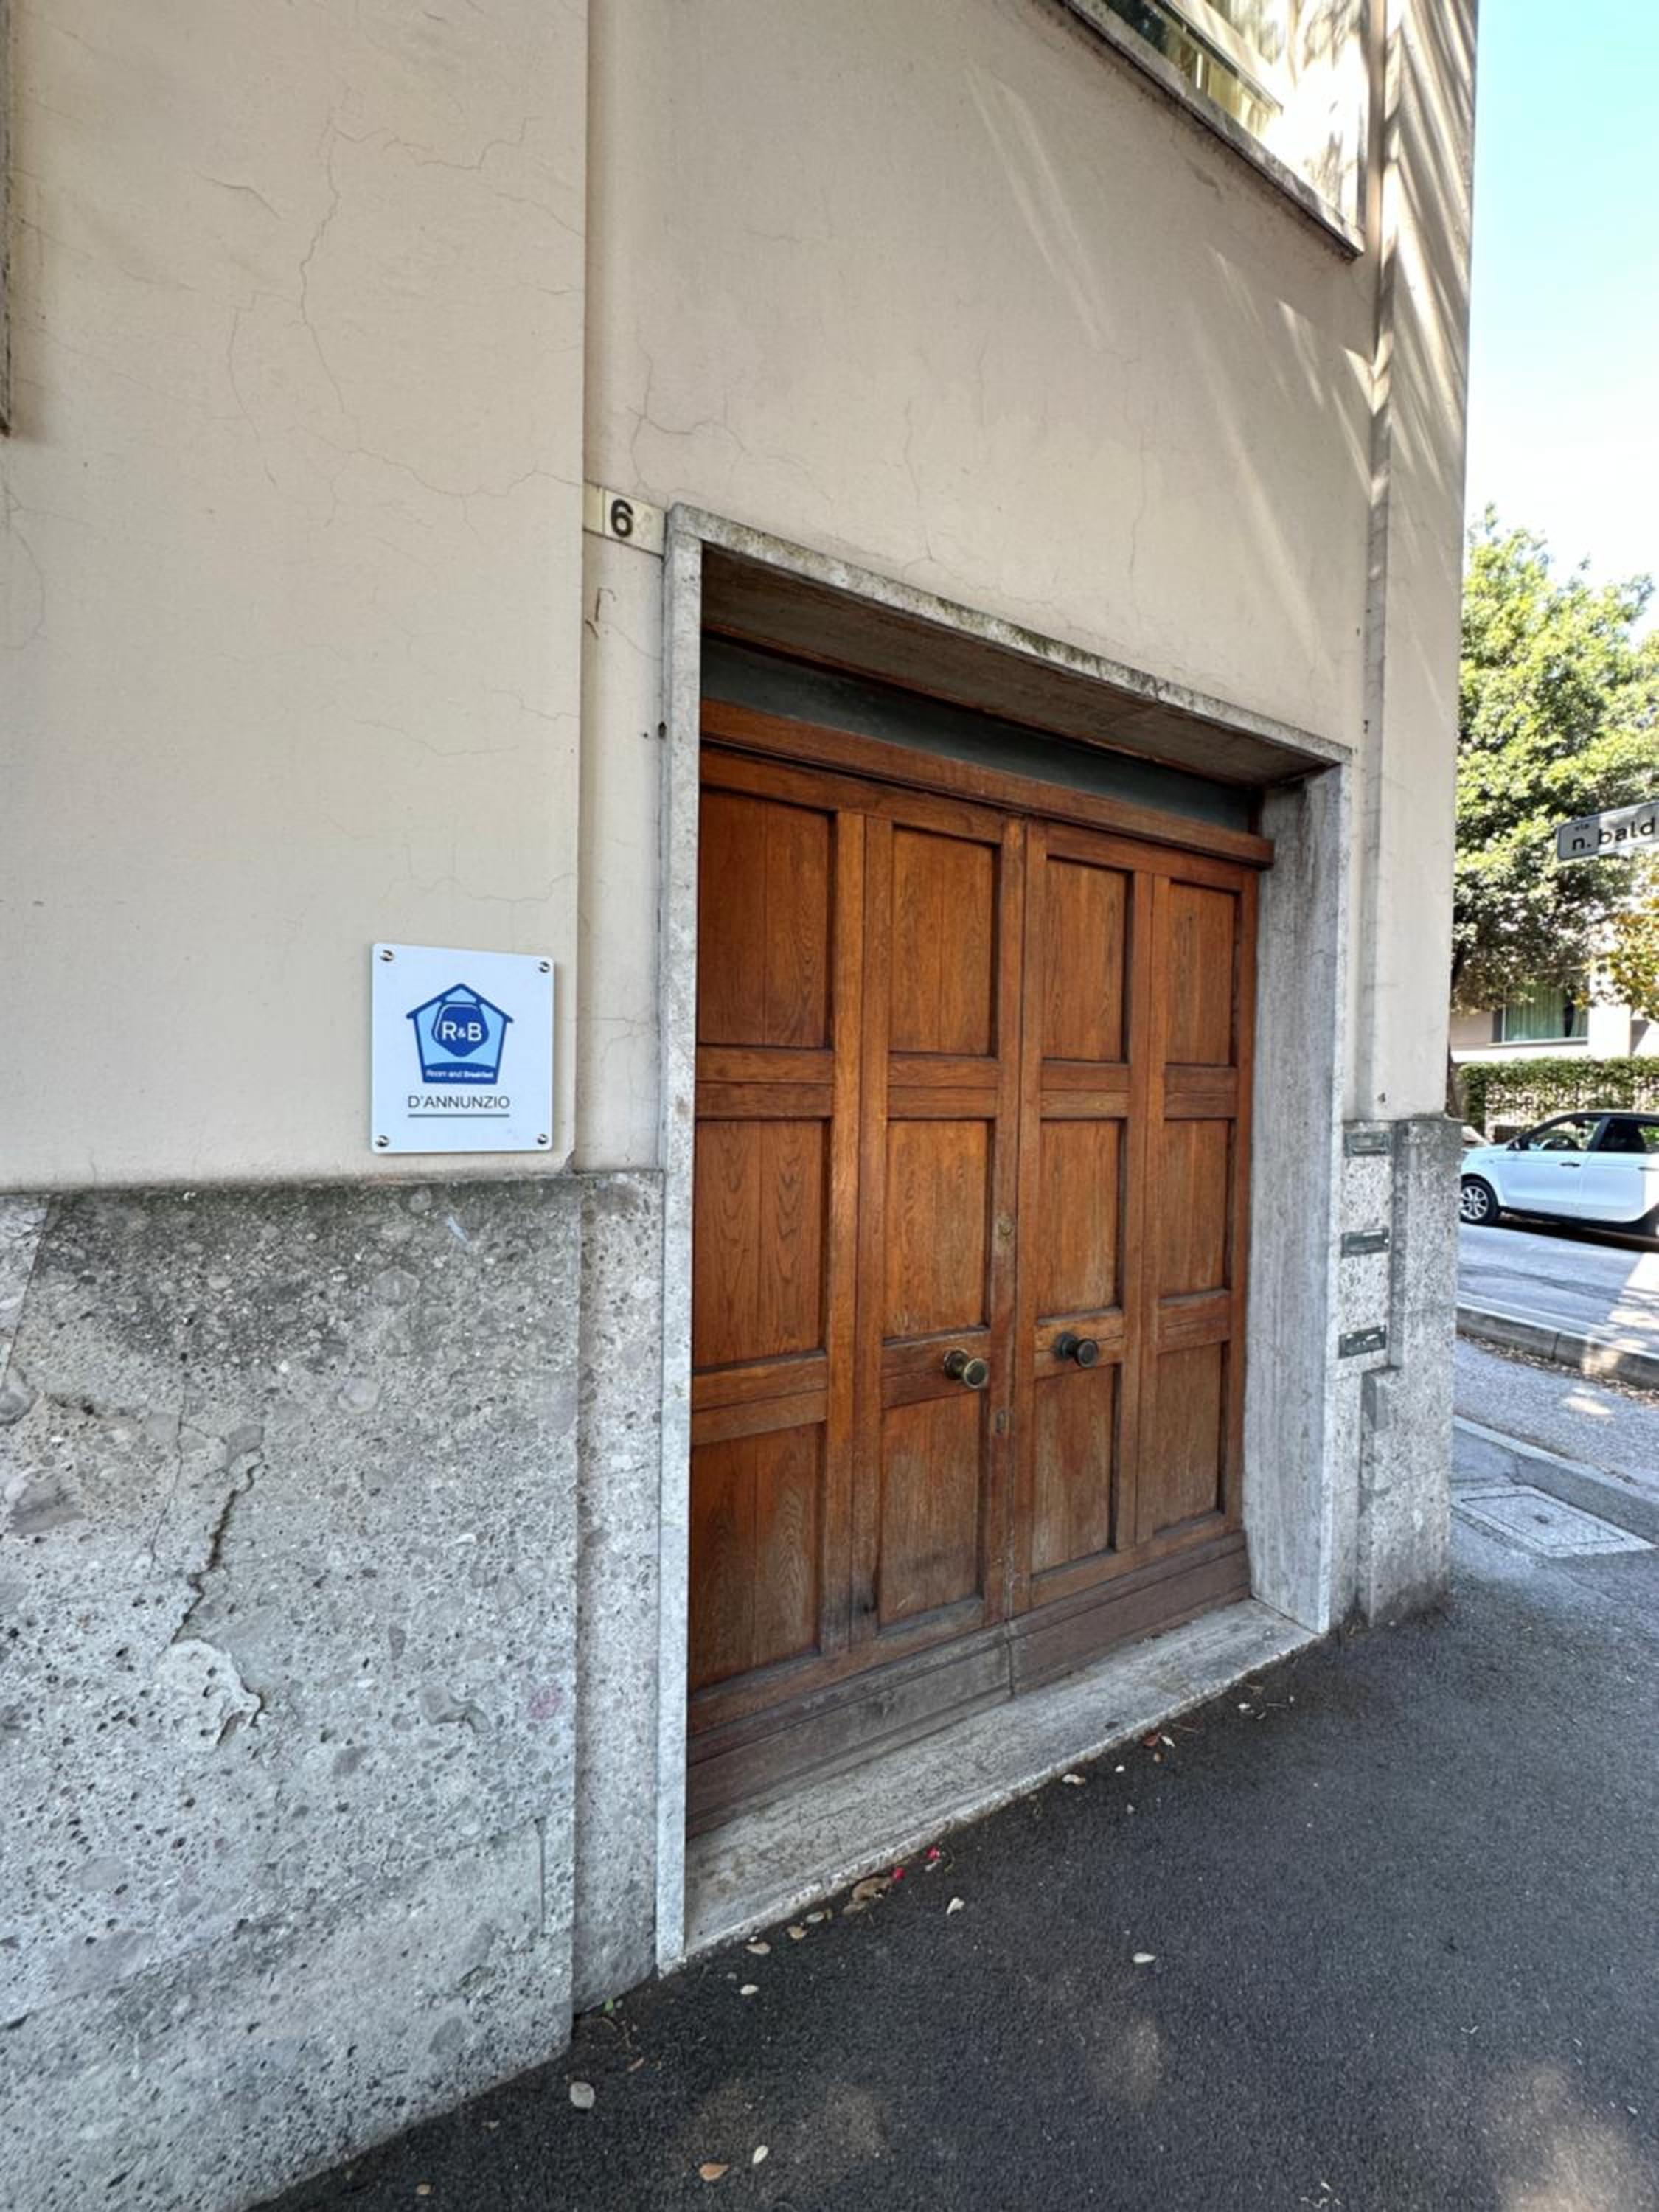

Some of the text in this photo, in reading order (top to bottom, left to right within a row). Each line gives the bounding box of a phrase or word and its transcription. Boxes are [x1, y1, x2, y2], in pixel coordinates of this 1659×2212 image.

[611, 498, 633, 538] 6
[442, 1021, 482, 1042] R&B
[407, 1094, 510, 1110] D'ANNUNZIO
